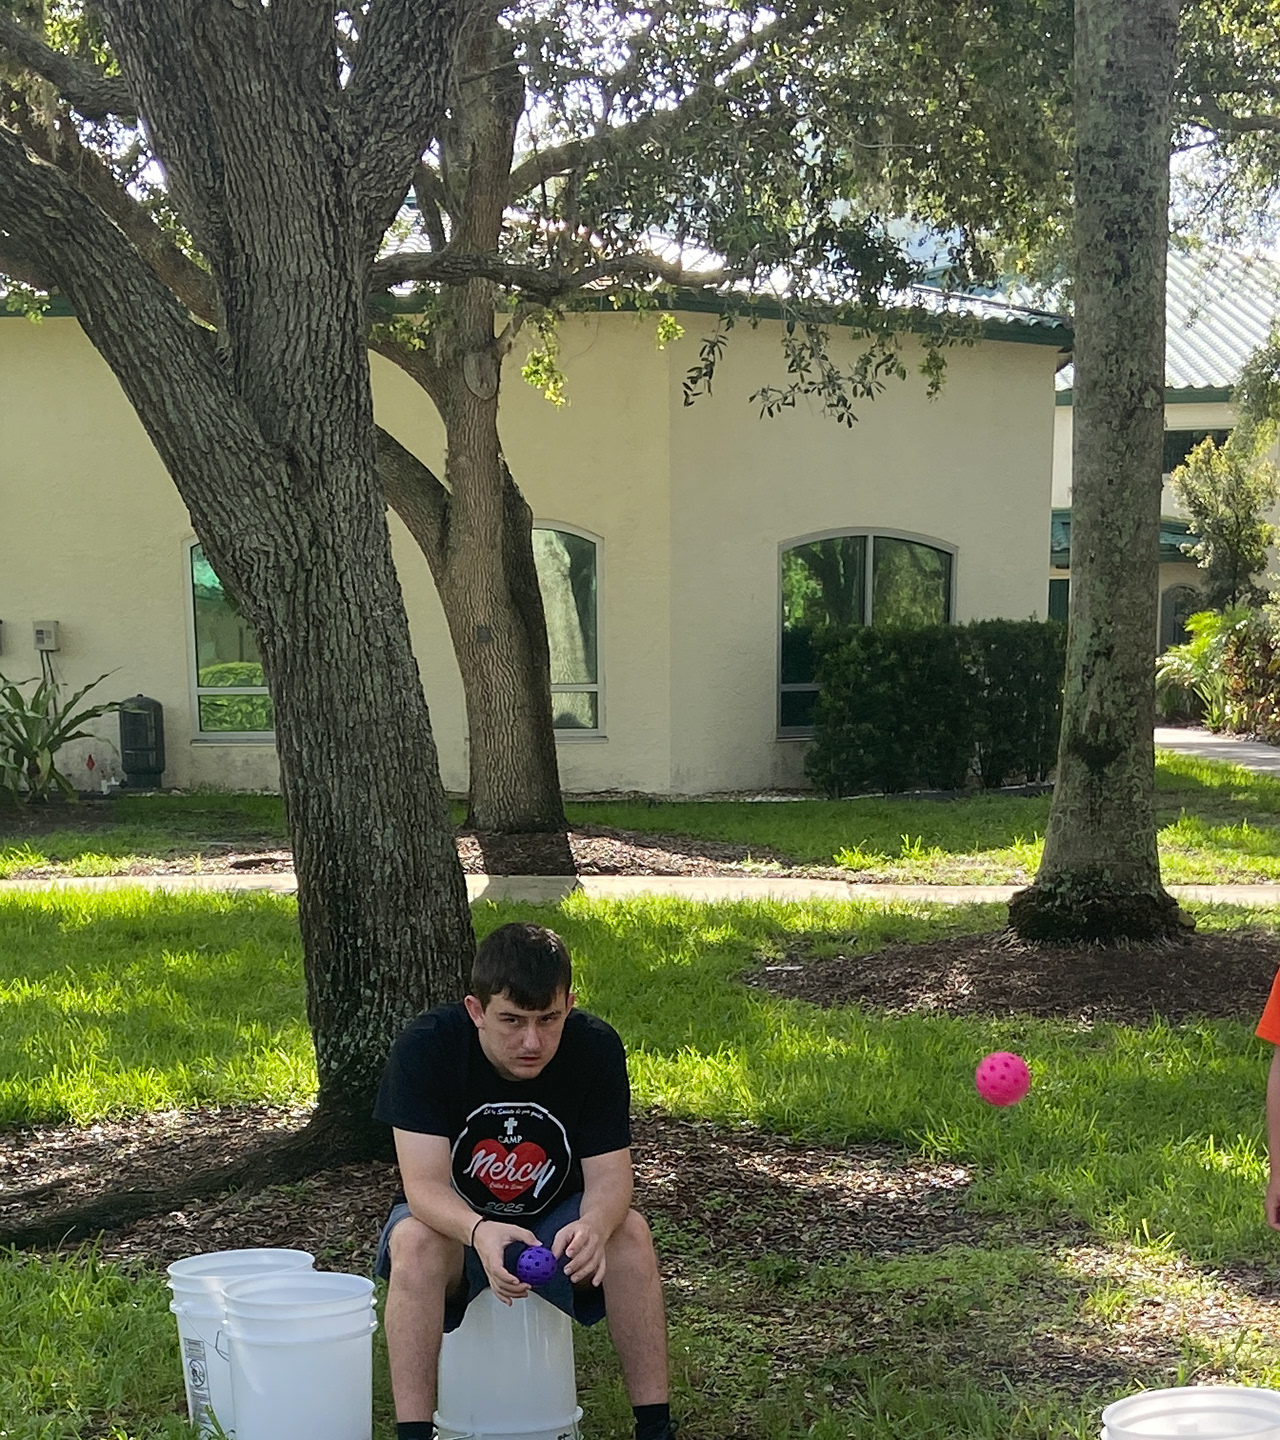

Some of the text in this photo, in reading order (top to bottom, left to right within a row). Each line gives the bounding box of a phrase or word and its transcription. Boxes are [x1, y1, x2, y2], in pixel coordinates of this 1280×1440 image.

[497, 1134, 523, 1144] CAMP
[462, 1148, 556, 1199] Mercy
[485, 1201, 526, 1214] 2025
